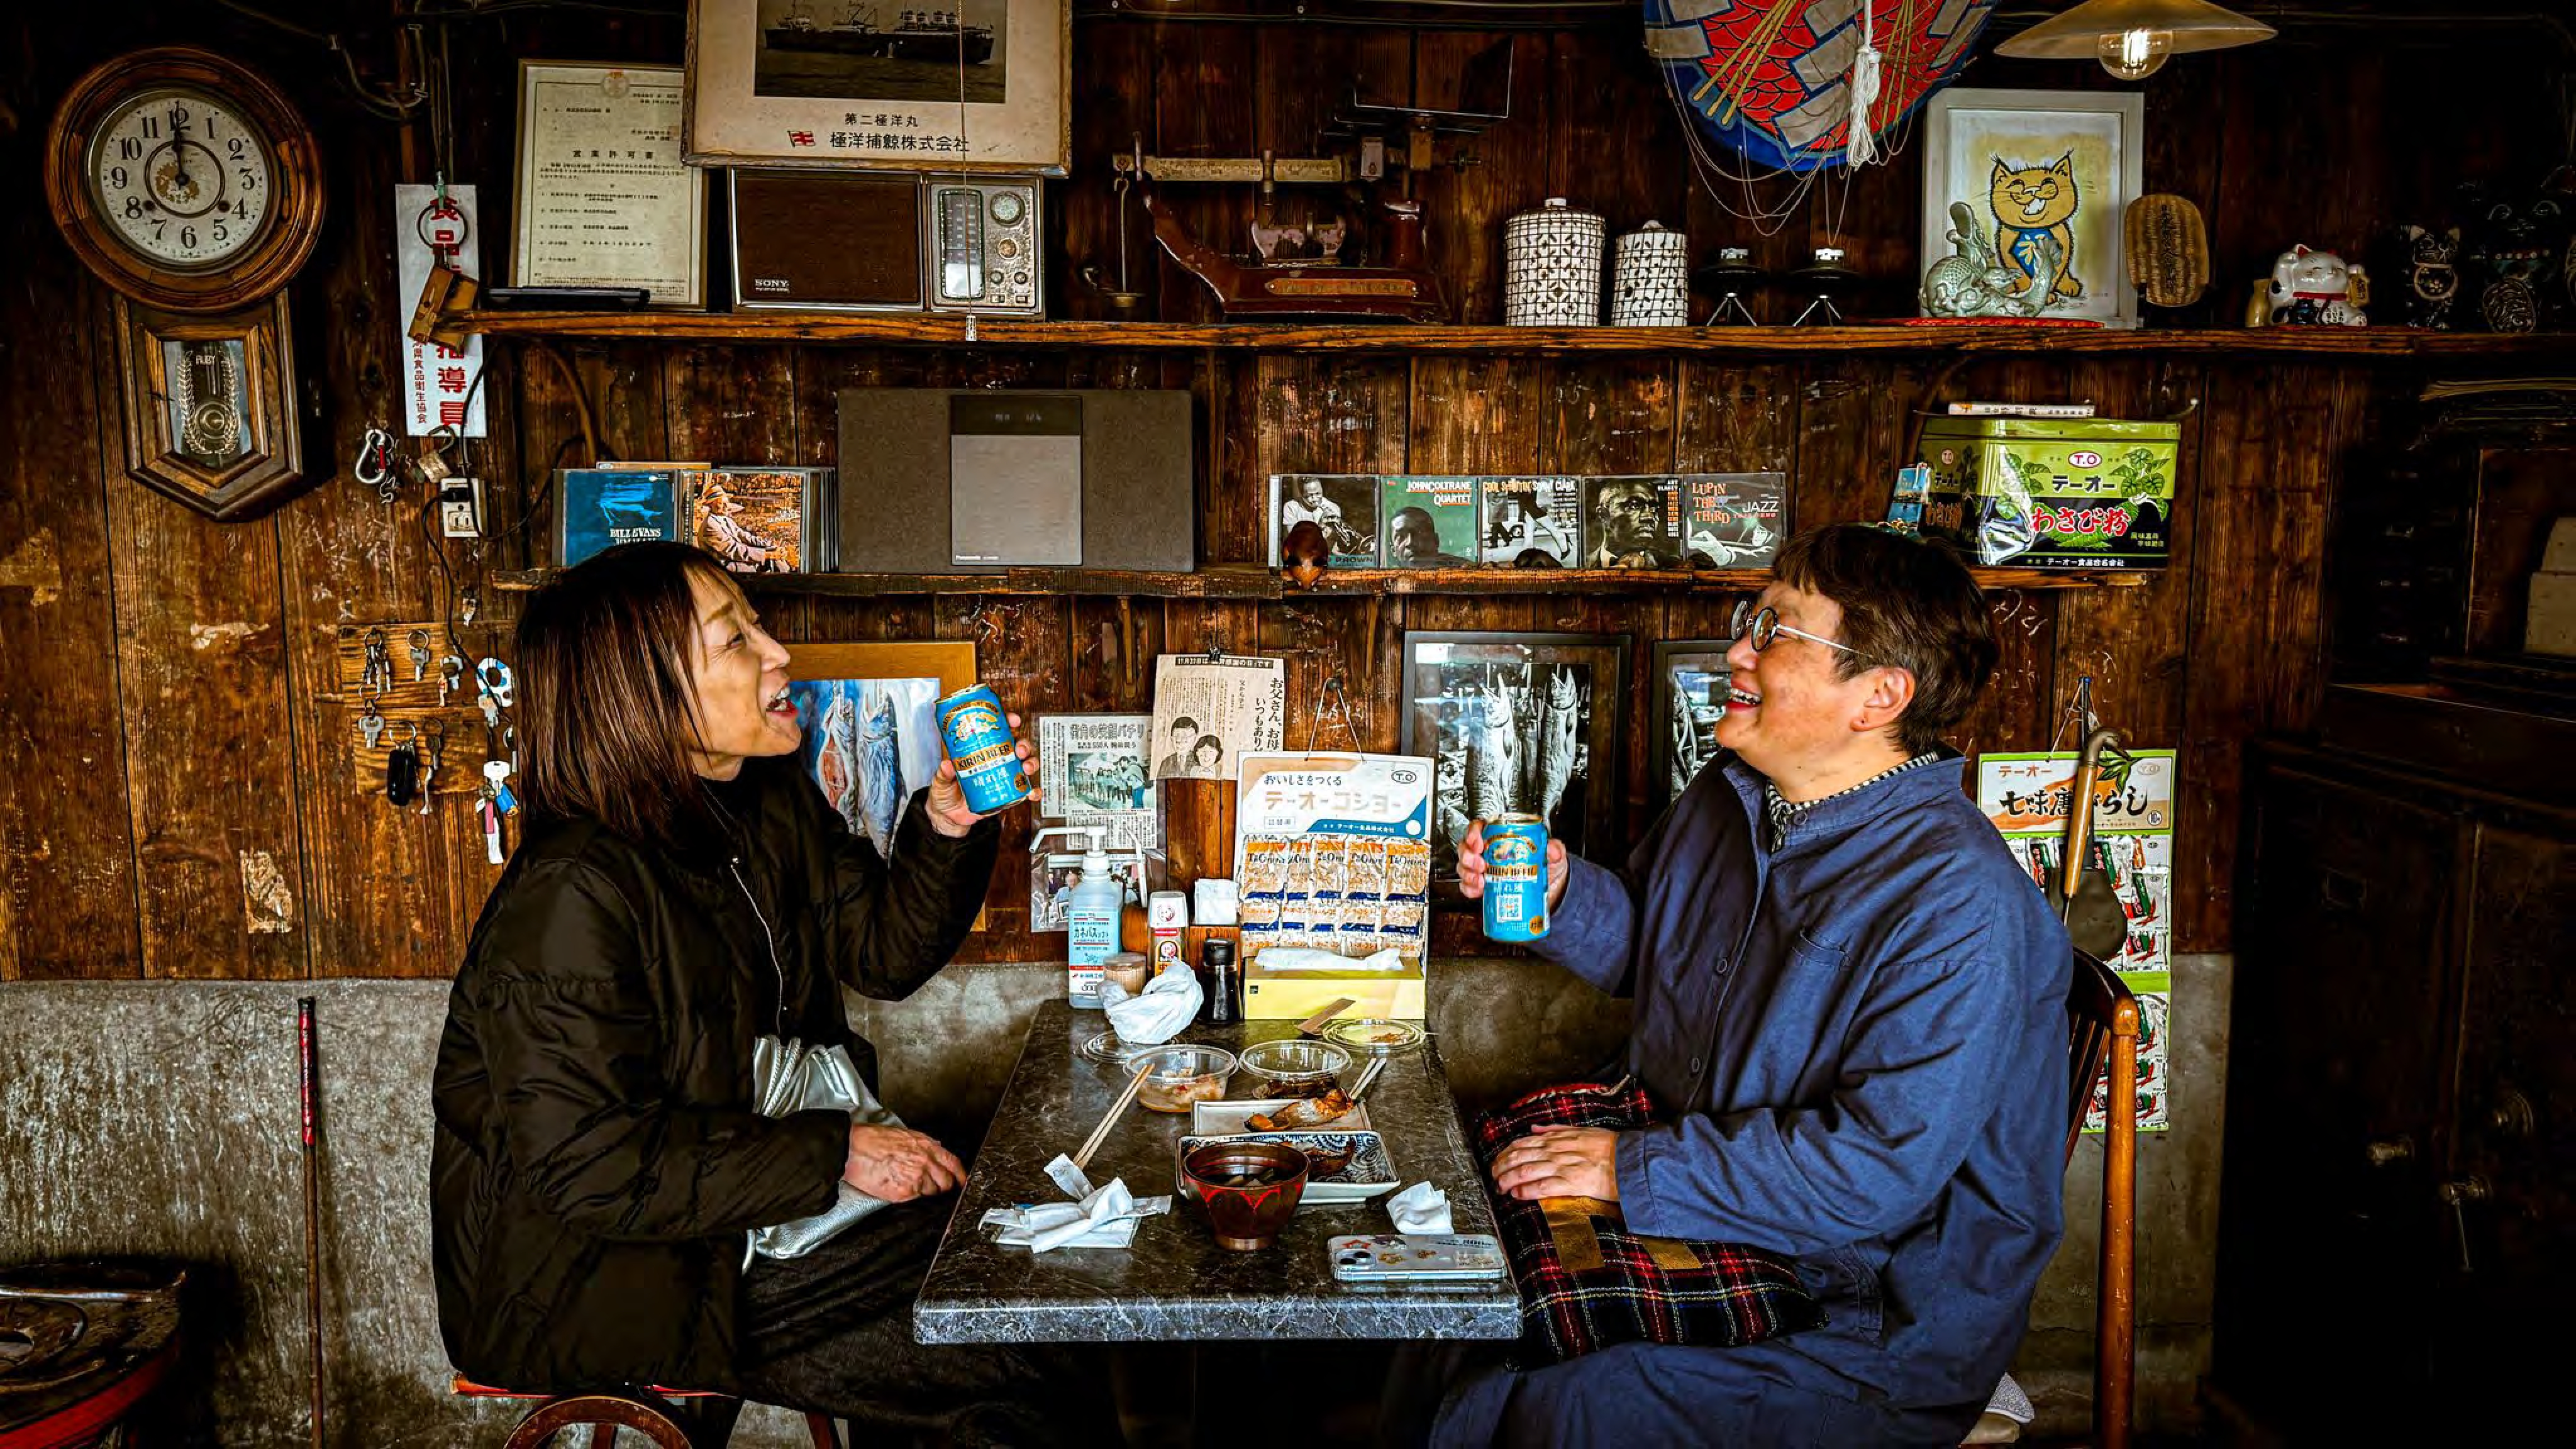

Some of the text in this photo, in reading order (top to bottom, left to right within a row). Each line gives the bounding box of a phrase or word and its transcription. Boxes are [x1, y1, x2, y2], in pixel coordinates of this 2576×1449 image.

[142, 117, 160, 138] 11
[169, 108, 191, 131] 12
[206, 117, 215, 140] 1
[845, 113, 919, 127] 第二極洋丸
[120, 137, 142, 160] 10
[228, 138, 244, 160] 2
[830, 131, 970, 152] 極洋捕鯨株式会社
[111, 167, 128, 189] 9
[239, 168, 255, 190] 3
[126, 196, 142, 219] 8
[231, 197, 248, 219] 4
[151, 219, 167, 240] 7
[180, 226, 197, 248] 6
[213, 219, 228, 241] 5
[755, 279, 789, 287] SONY
[196, 354, 216, 365] RUBY
[2075, 455, 2096, 465] T.O
[1407, 480, 1472, 492] JOHN COLTRANE
[1691, 482, 1726, 496] LUPIN
[2051, 475, 2116, 493] テーオー
[1434, 494, 1471, 506] QUARTET
[1692, 496, 1716, 509] THE
[1742, 501, 1779, 513] JAZZ
[1694, 510, 1731, 524] THIRD
[2031, 507, 2131, 536] わさび粉
[609, 527, 662, 538] BILL EVANS
[1253, 697, 1266, 752] いつもあり
[958, 753, 985, 769] KIRIN
[1999, 765, 2053, 778] テーオー
[1264, 774, 1342, 786] おいしさをつくる
[1396, 772, 1413, 782] T.O
[1265, 791, 1402, 814] テーオーコショー
[1999, 786, 2148, 816] 七味唐らし
